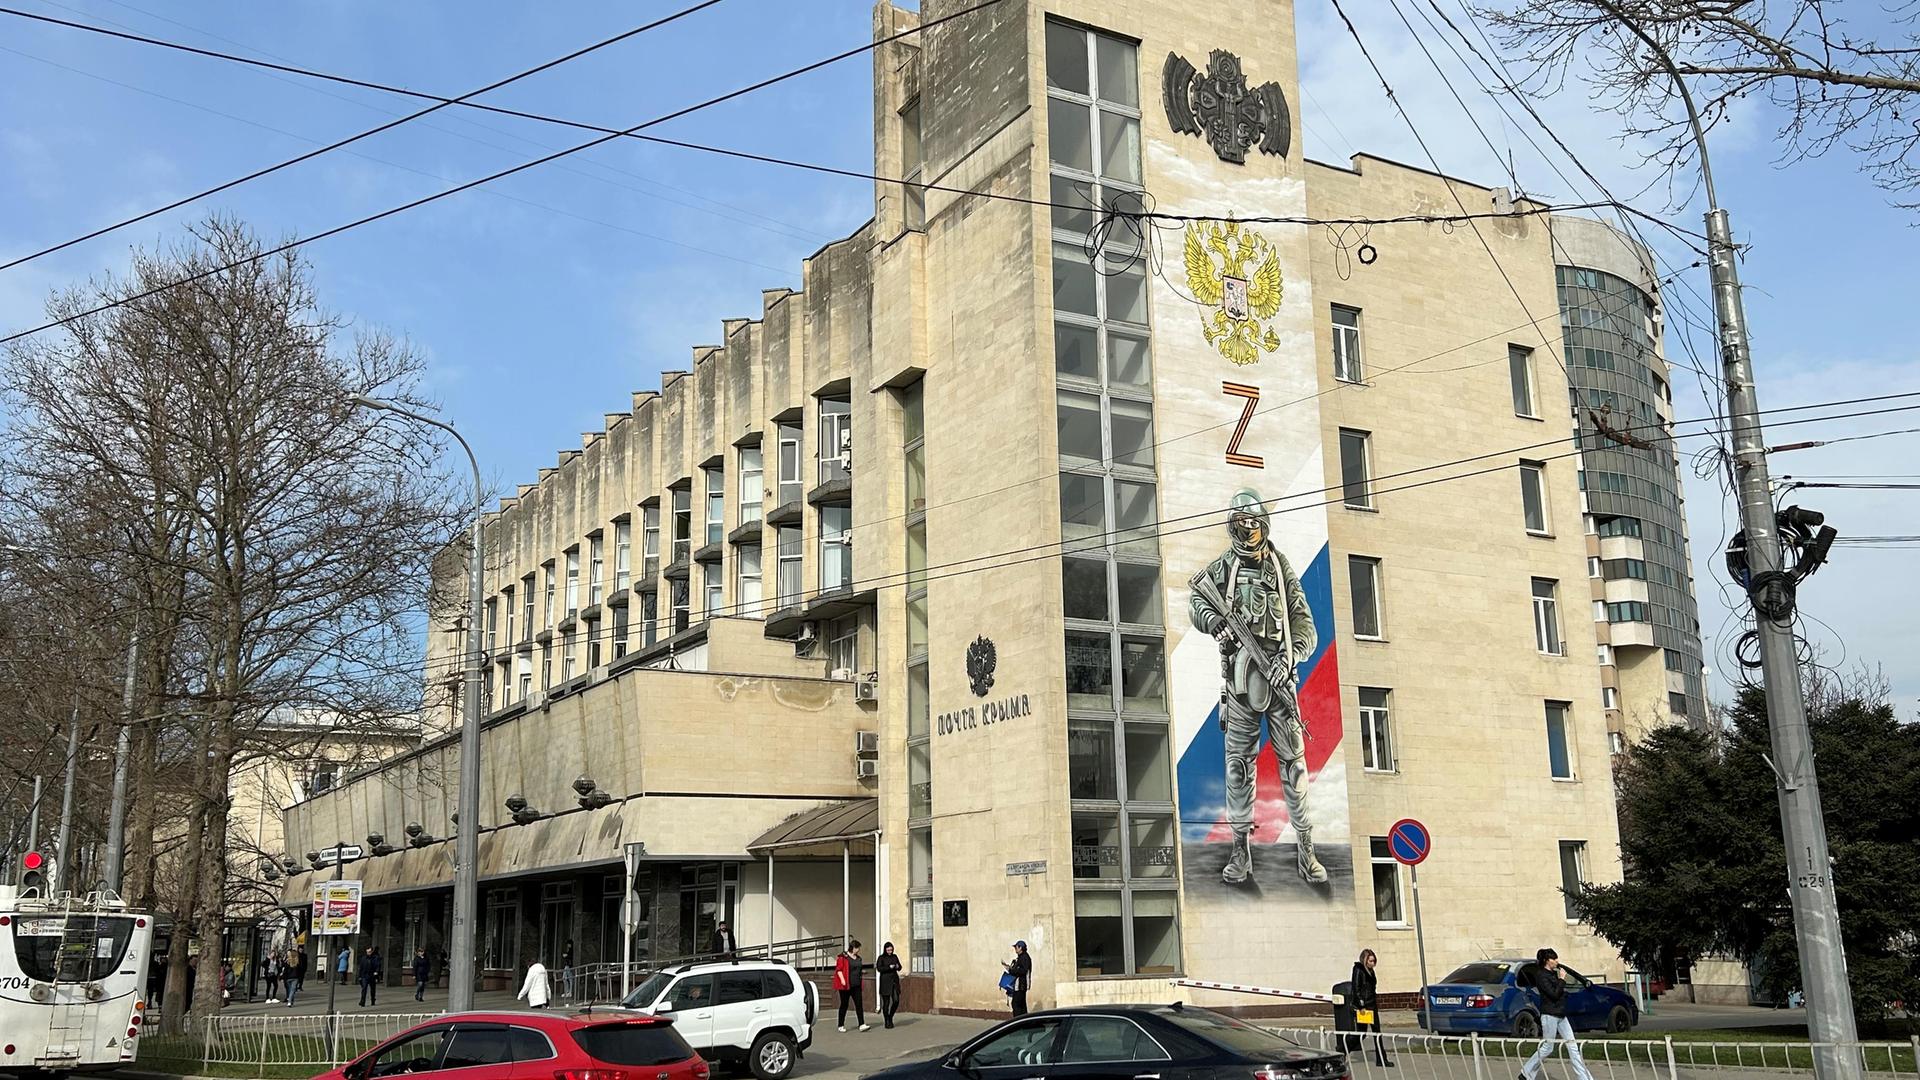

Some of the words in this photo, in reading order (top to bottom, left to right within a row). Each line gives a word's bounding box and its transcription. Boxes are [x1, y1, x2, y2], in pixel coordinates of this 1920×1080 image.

[1222, 381, 1264, 469] Z
[937, 707, 977, 736] ПОЧТА
[982, 694, 1031, 726] КРЫМА
[0, 976, 31, 990] 704
